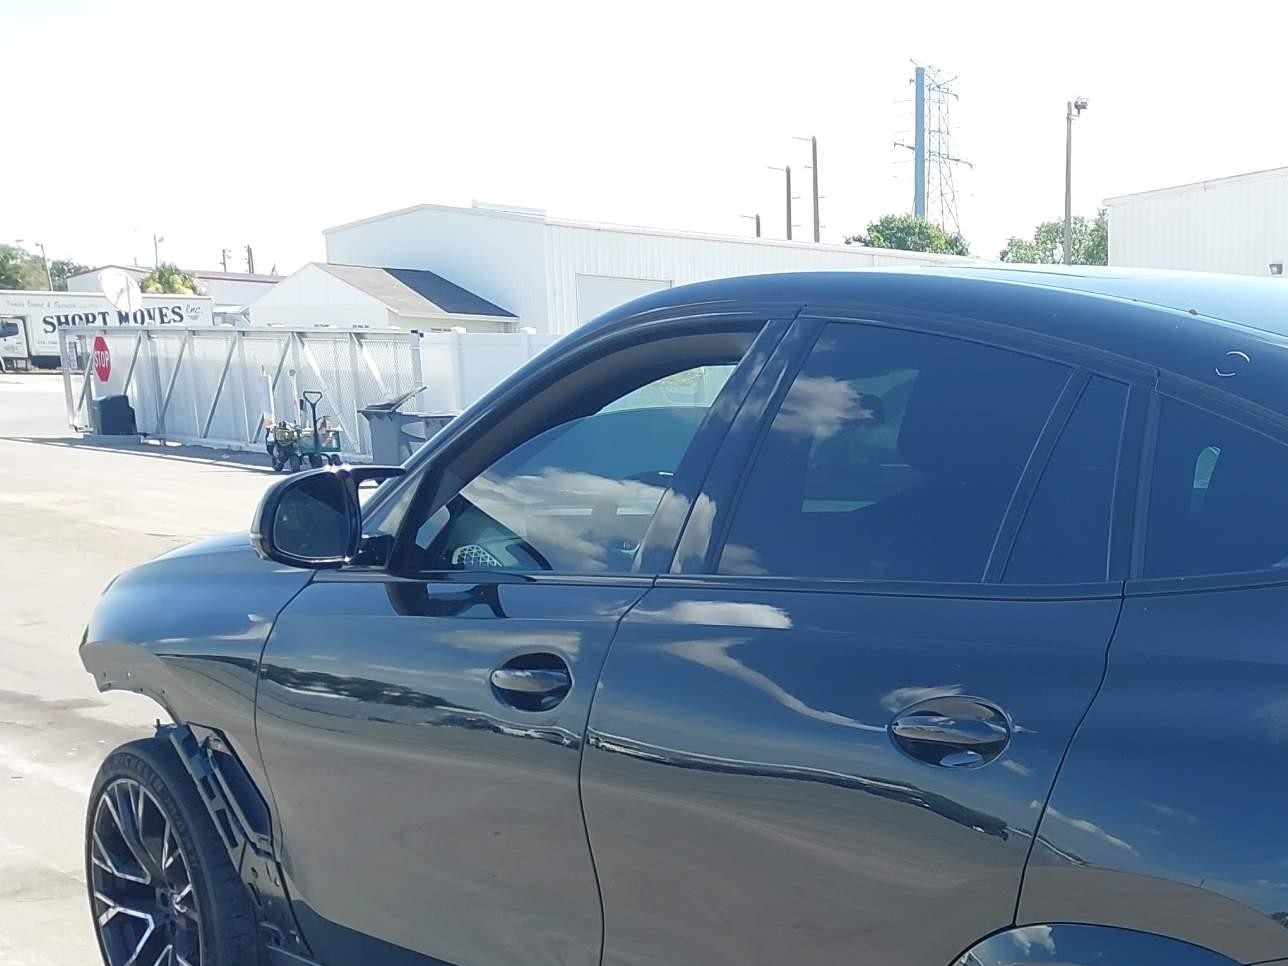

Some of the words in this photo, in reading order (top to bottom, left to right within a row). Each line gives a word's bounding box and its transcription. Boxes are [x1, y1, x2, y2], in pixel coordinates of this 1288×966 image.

[43, 311, 109, 333] SHORT
[116, 305, 184, 326] MOVES
[94, 351, 110, 369] STOP
